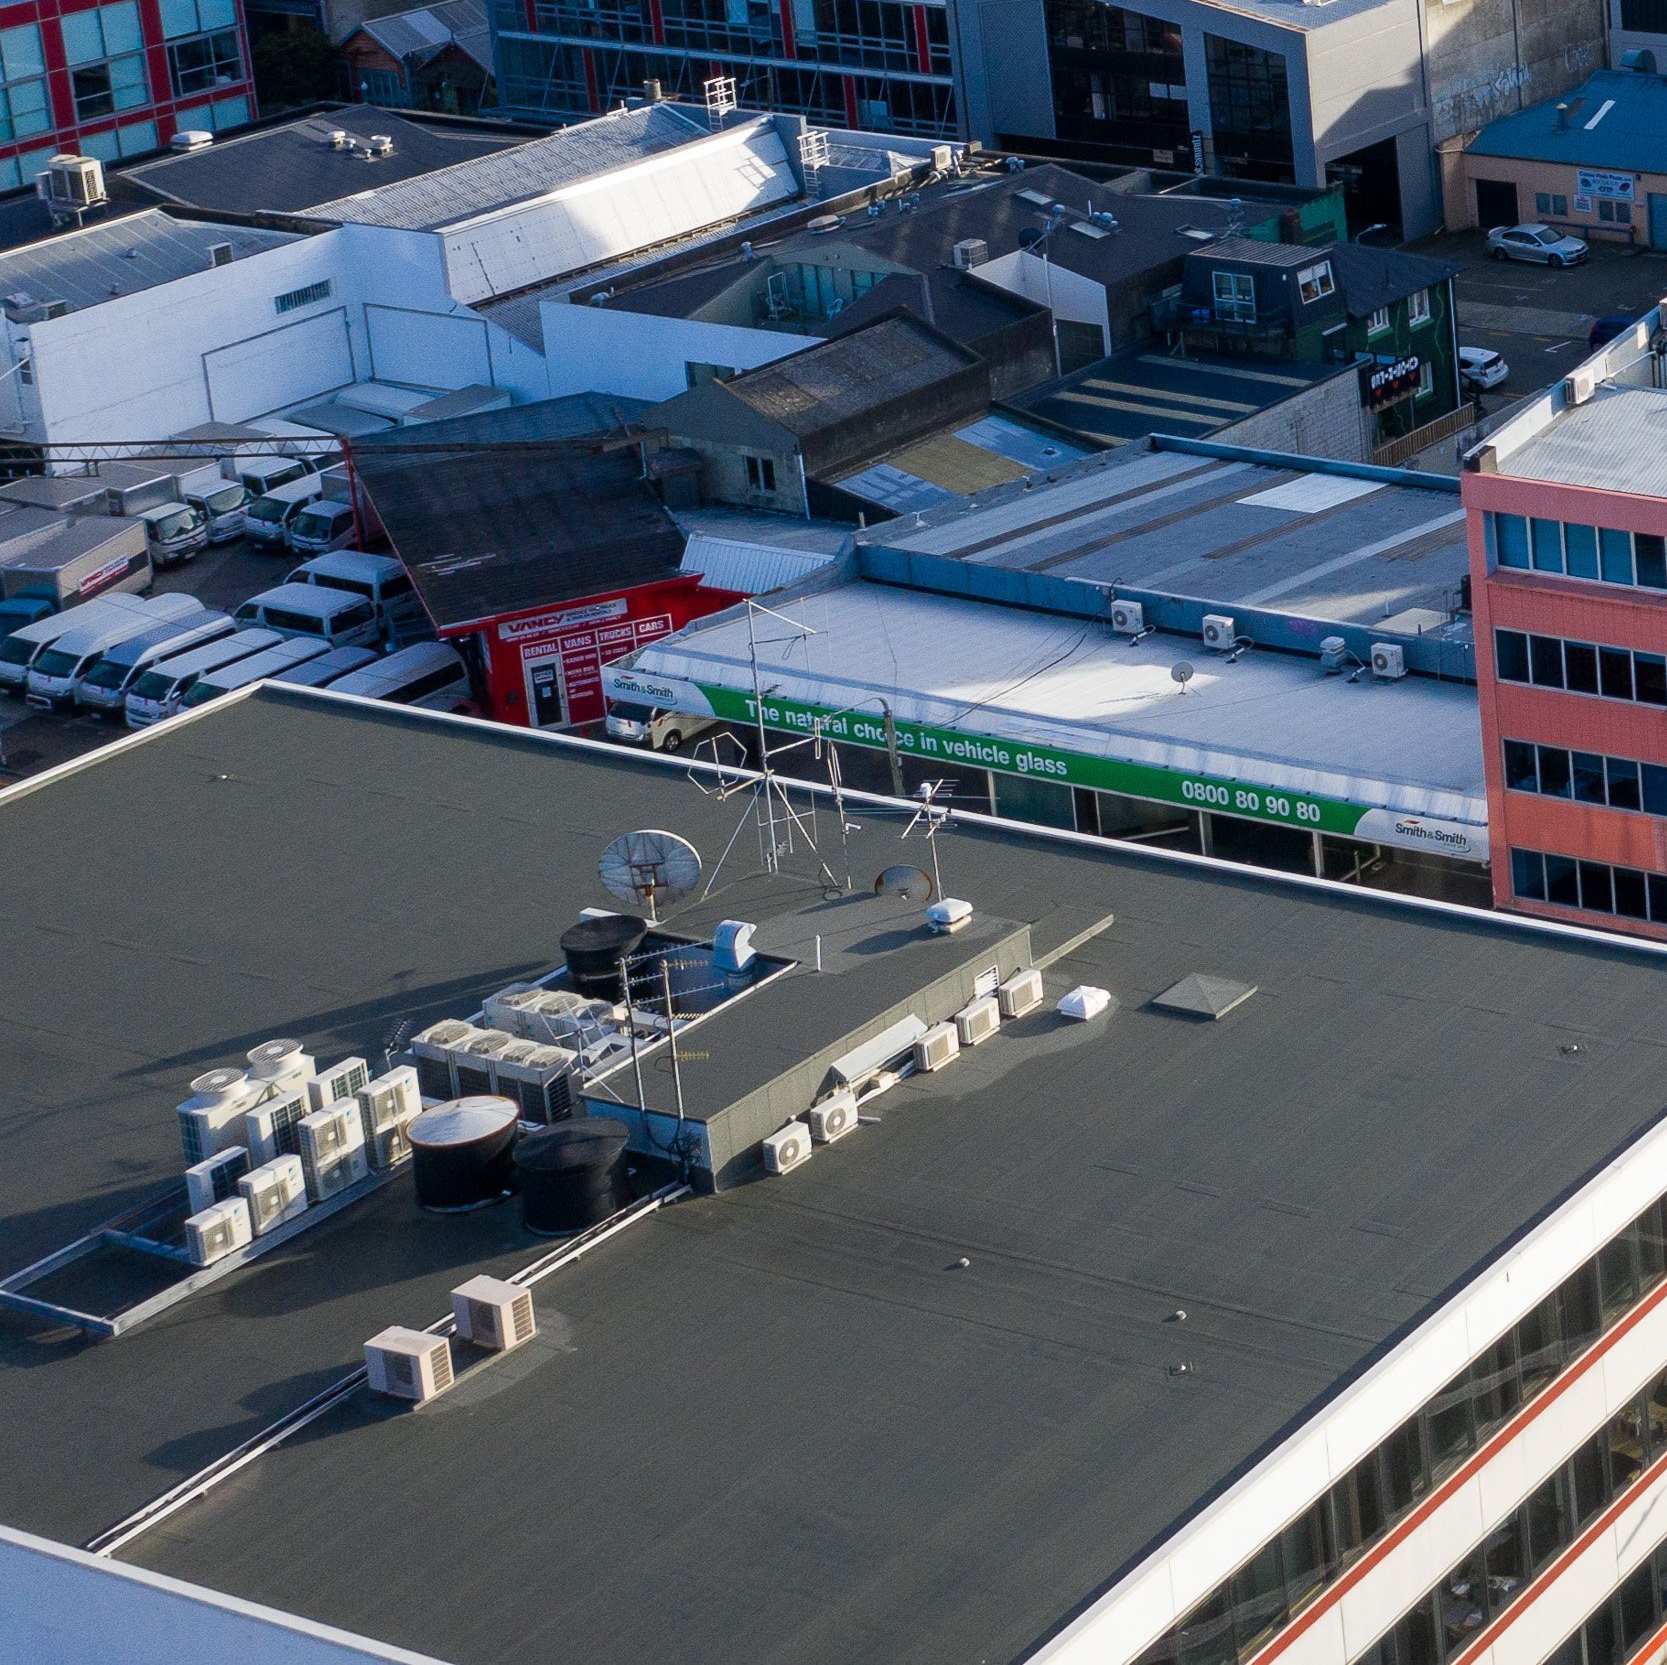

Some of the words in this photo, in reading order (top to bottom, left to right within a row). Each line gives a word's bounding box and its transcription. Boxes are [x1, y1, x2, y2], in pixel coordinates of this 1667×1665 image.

[506, 614, 566, 633] VANCY
[638, 620, 665, 633] CARS
[563, 635, 592, 649] VANS
[599, 627, 632, 642] TRUCKS
[523, 642, 558, 658] RENTAL
[613, 678, 674, 699] Smith&Smith
[744, 699, 781, 722] The
[853, 721, 915, 748] choce
[920, 731, 938, 752] in
[942, 739, 1010, 765] vehicle
[1015, 752, 1068, 775] glass
[1181, 780, 1230, 806] 0800
[1235, 789, 1260, 811] 80
[1266, 796, 1290, 817] 90
[1296, 801, 1321, 823] 80
[1395, 822, 1467, 846] Smith&Smith
